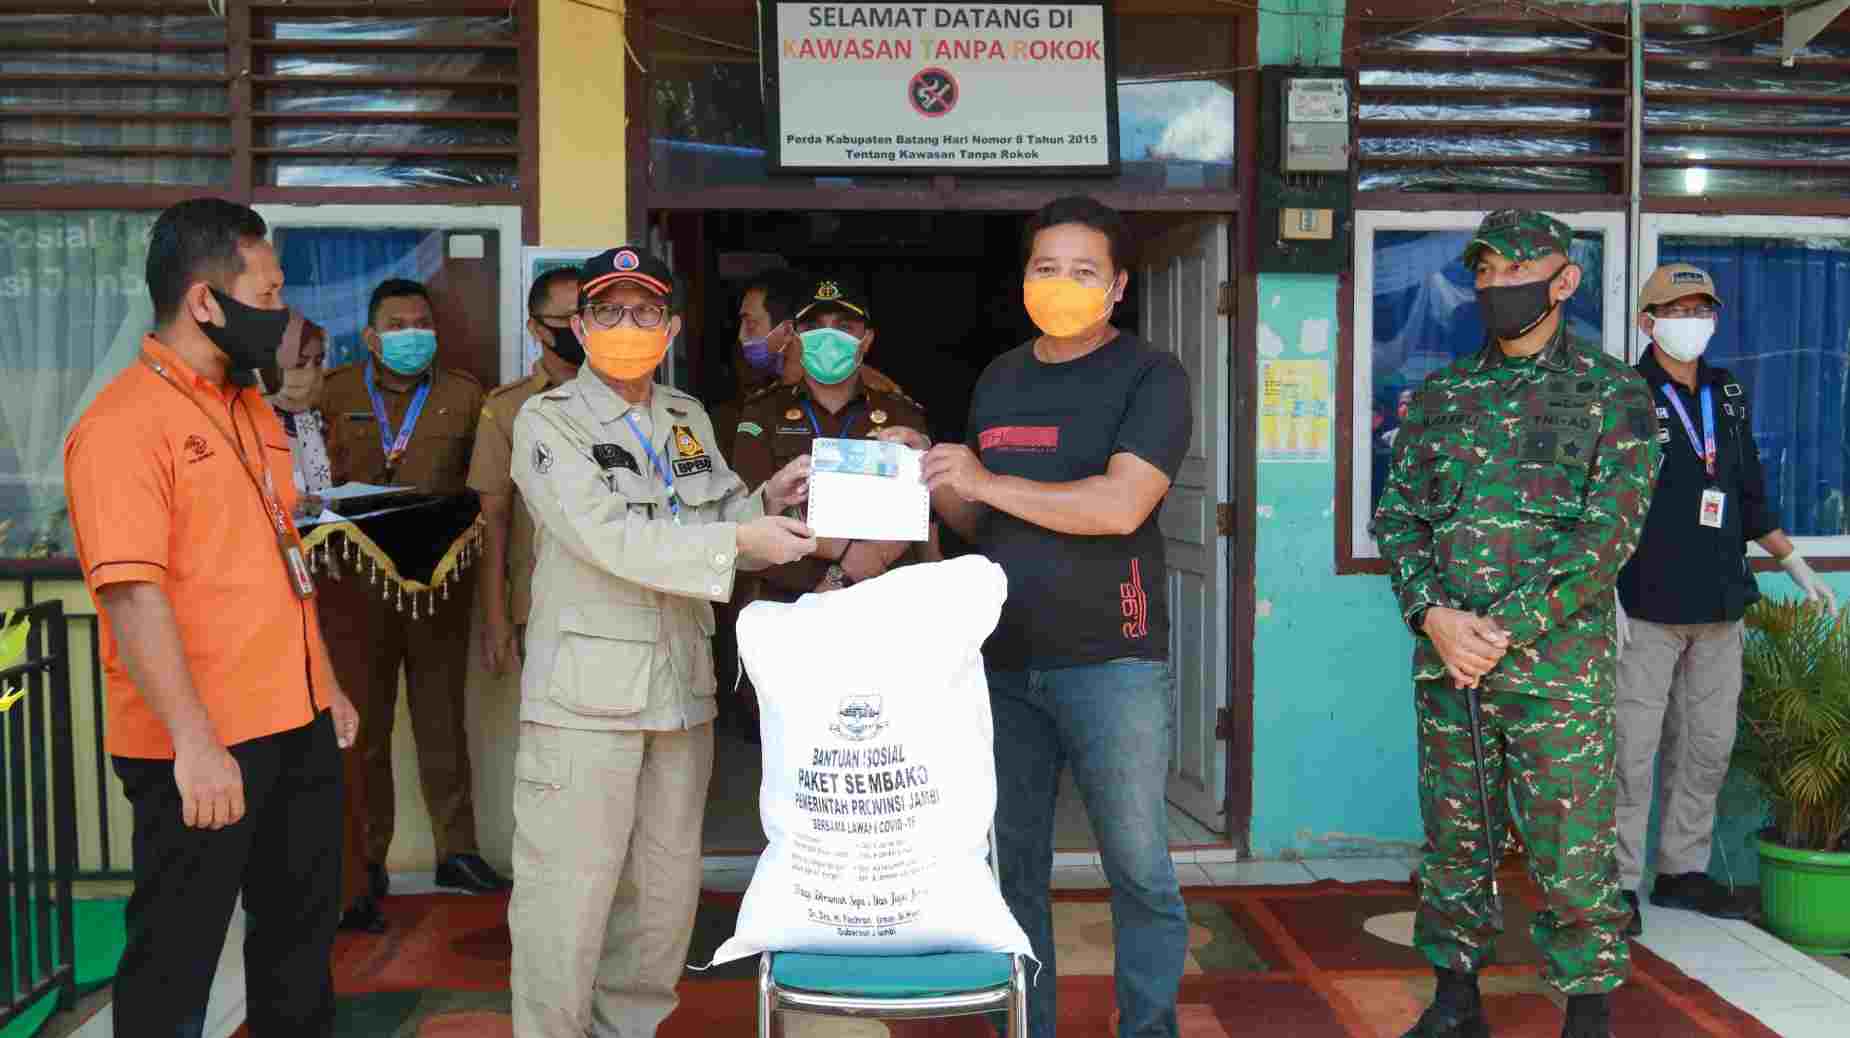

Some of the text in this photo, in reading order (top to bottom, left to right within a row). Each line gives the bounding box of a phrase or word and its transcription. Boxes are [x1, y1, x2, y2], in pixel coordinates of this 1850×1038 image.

[808, 6, 1073, 29] SELAMAT DATANG DI
[784, 39, 1101, 60] KAWASAN TANPA ROKOK
[786, 135, 822, 145] Perda
[826, 135, 893, 147] Kabupaten
[896, 135, 940, 147] Batang
[943, 135, 969, 145] Hari
[972, 135, 1012, 145] Nomor
[1027, 135, 1064, 145] Tahun
[1068, 134, 1099, 145] 2015
[845, 149, 1039, 161] Tentang Kawasan Tanpa Rokok
[812, 747, 860, 768] BANTUAN
[798, 765, 929, 794] PAKET SEMBAKO
